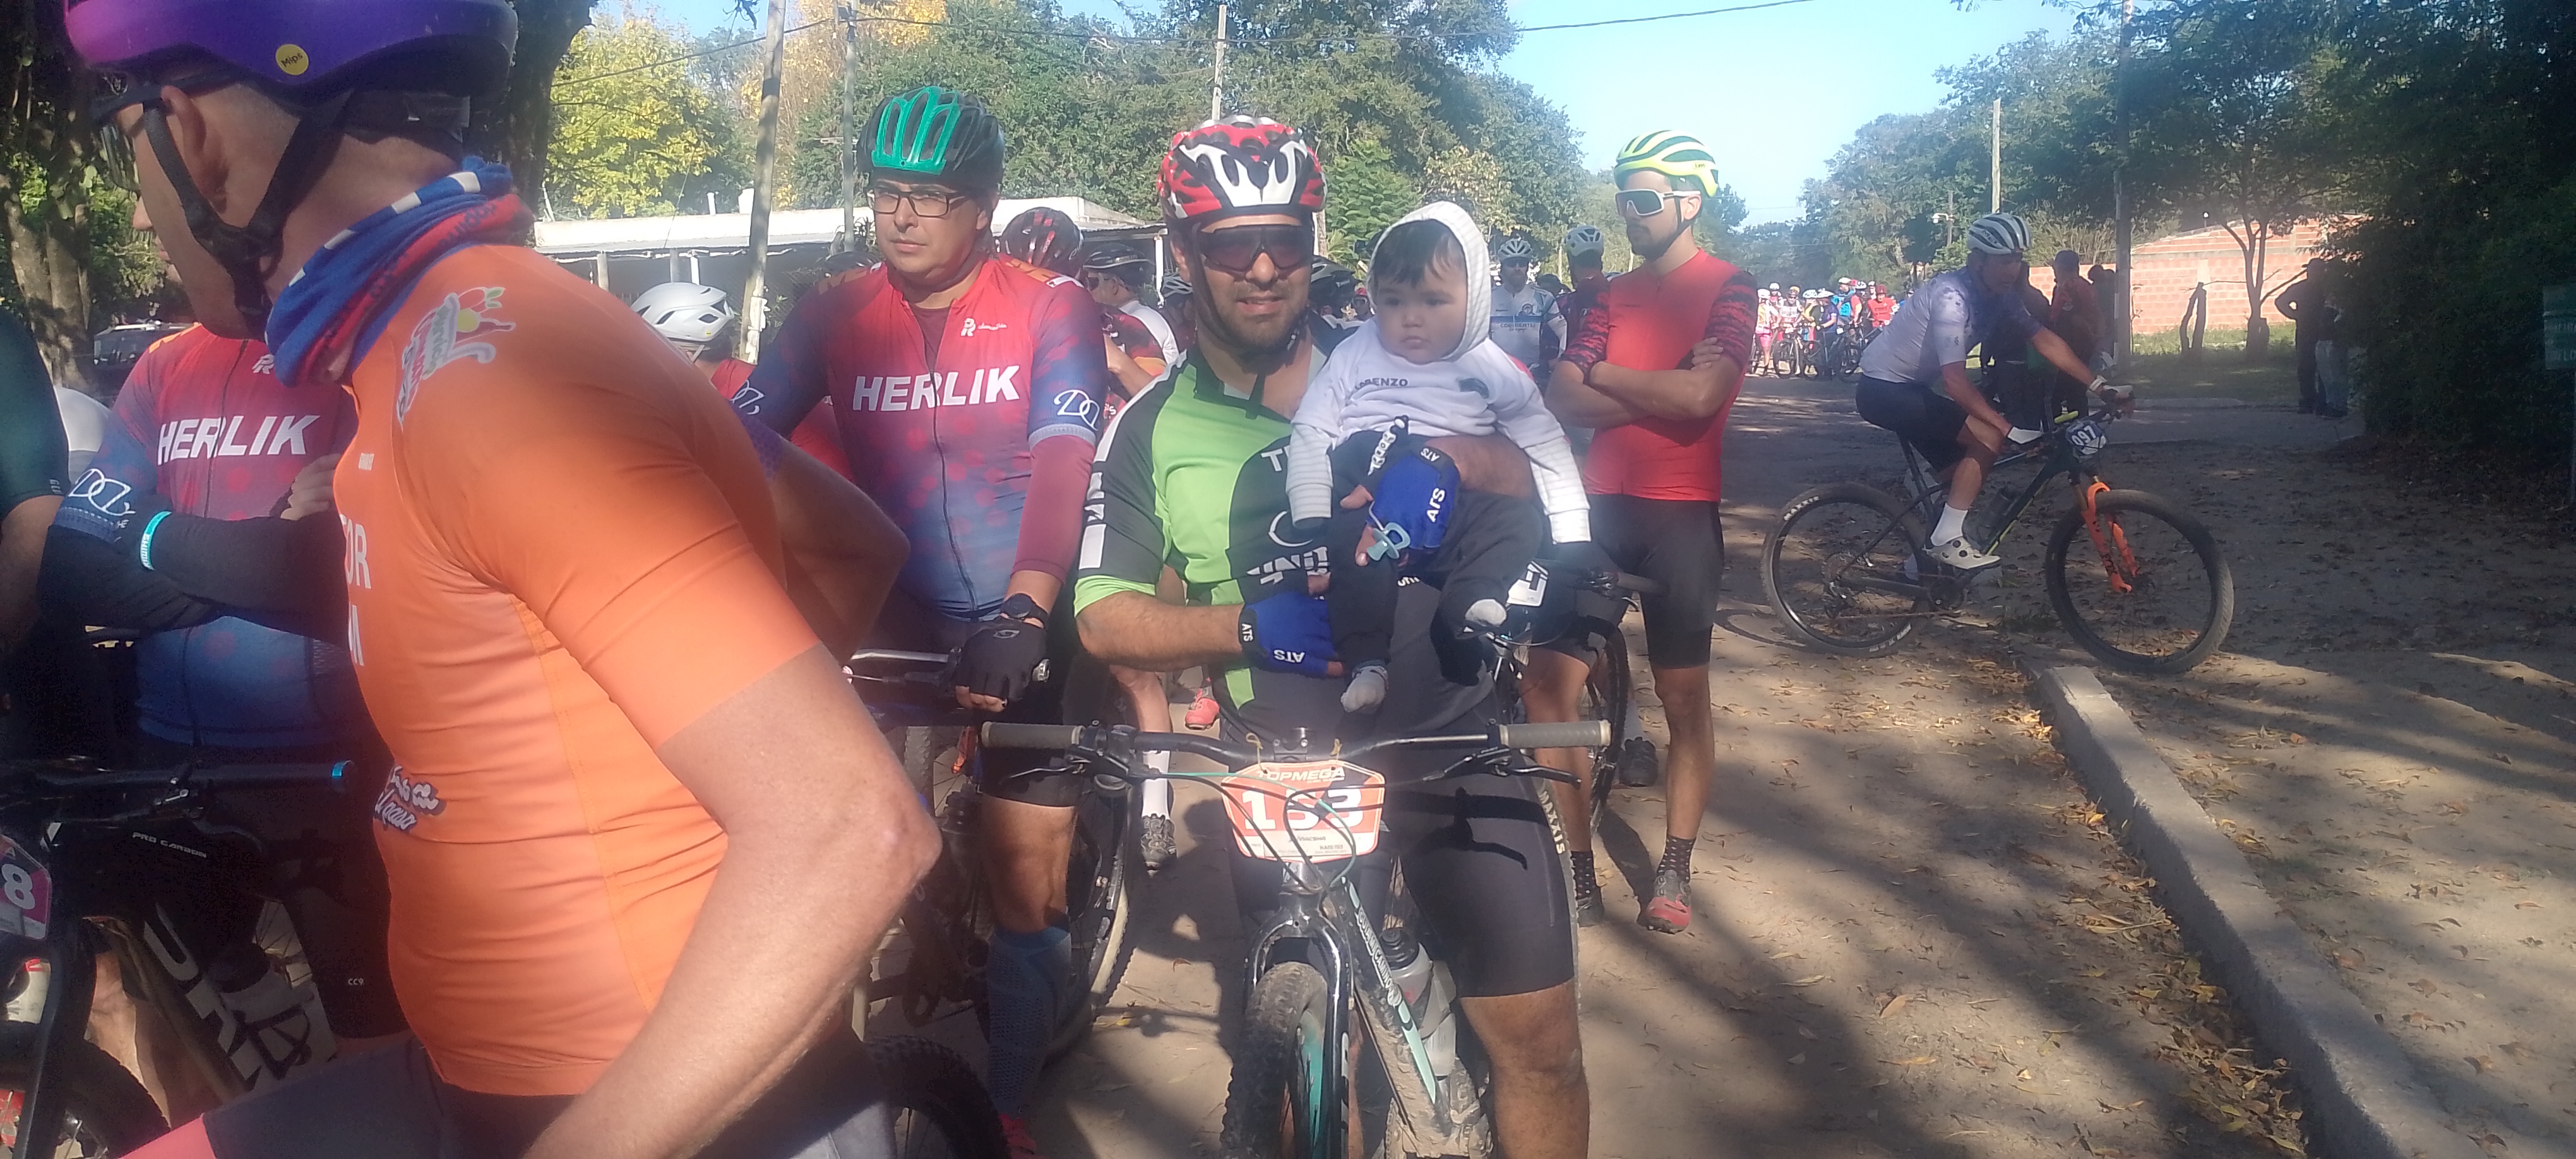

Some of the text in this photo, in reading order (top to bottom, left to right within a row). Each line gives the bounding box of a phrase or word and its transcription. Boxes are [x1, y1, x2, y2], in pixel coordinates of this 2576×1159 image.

[280, 52, 303, 68] Mips
[852, 365, 1020, 411] HERLIK
[1354, 377, 1408, 391] LORENZO
[157, 415, 321, 467] HERLIK
[2071, 425, 2096, 446] 097
[1420, 448, 1440, 462] ATS
[1426, 488, 1445, 523] ATS
[1241, 623, 1254, 642] ATS
[1273, 649, 1305, 663] ATS
[1256, 767, 1345, 781] TOPMEGA
[1539, 790, 1565, 854] MAXXIS
[132, 831, 207, 859] PRO CARBON
[1374, 949, 1392, 988] CAMINO
